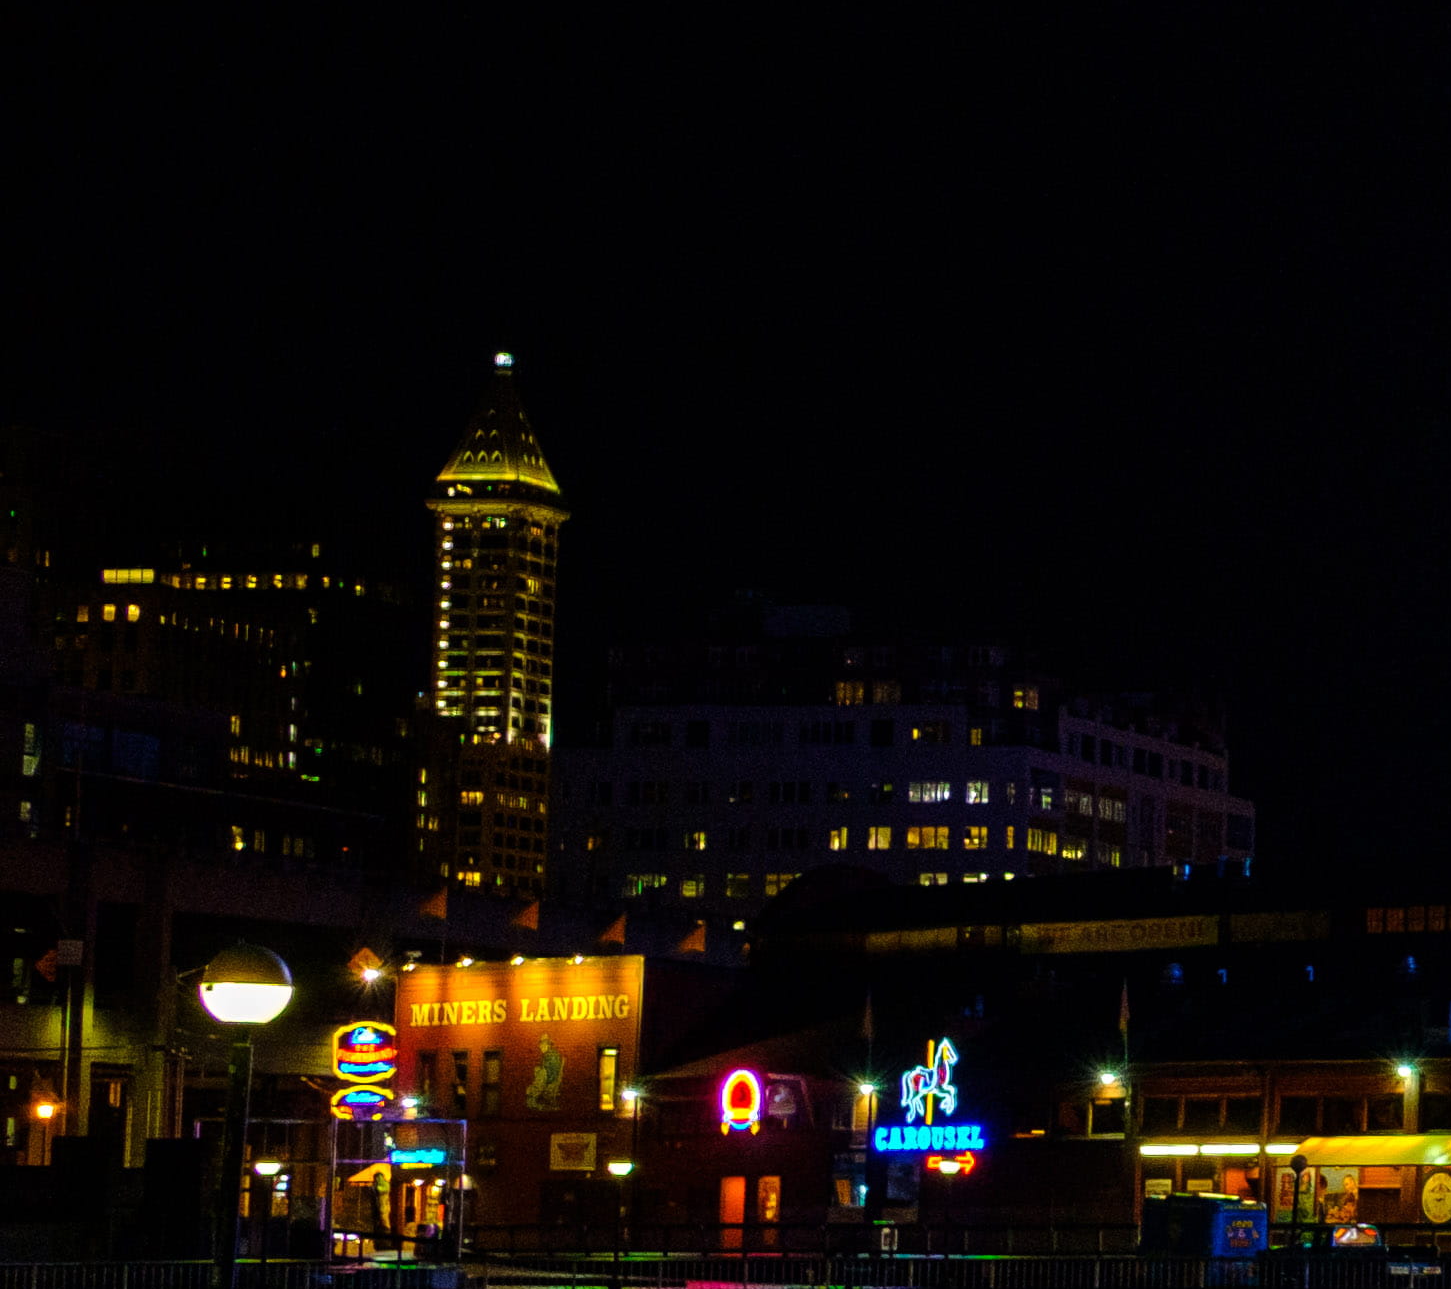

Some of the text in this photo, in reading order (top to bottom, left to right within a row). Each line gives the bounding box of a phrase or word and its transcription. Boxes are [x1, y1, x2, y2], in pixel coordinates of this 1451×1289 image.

[410, 994, 630, 1027] MINERS LANDING
[875, 1125, 985, 1151] CAROUSEL
